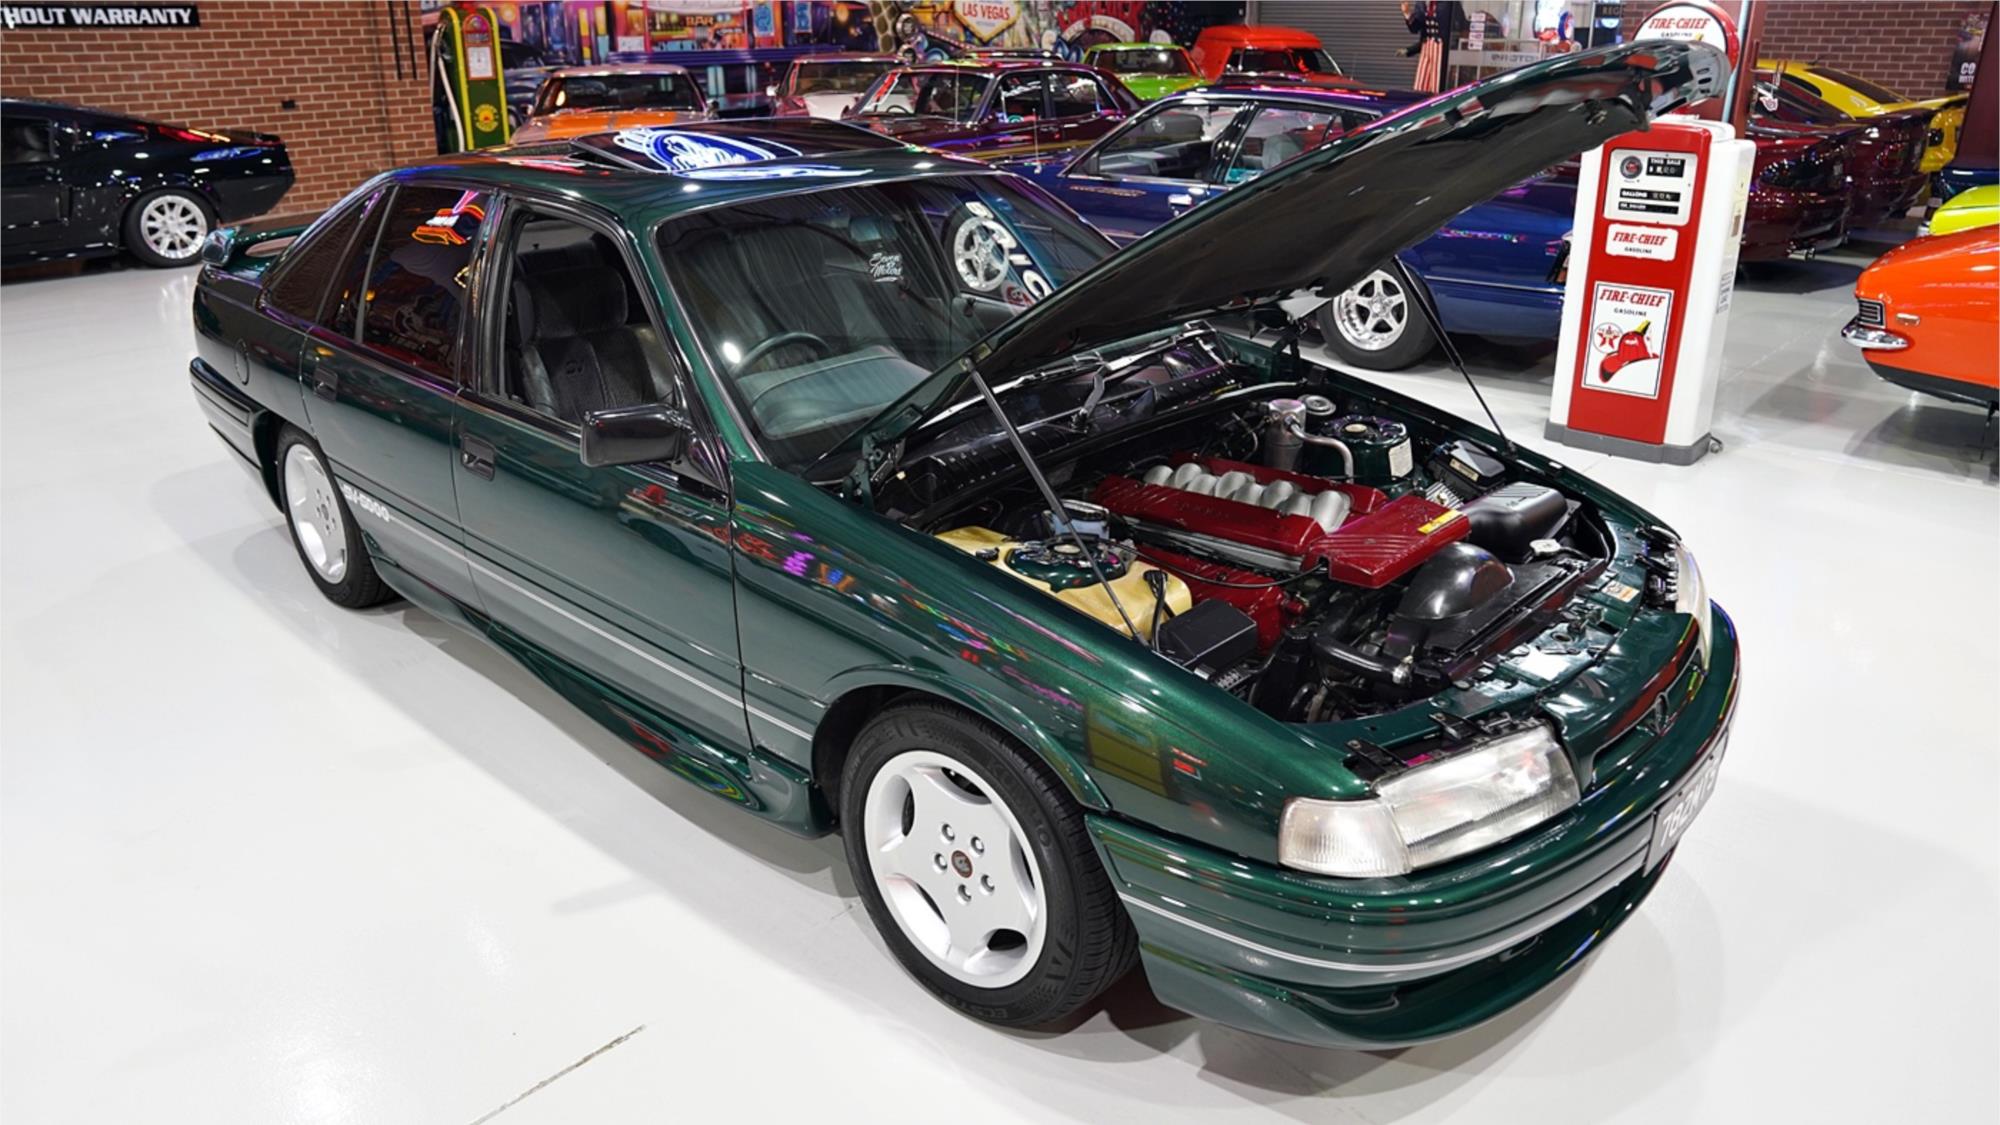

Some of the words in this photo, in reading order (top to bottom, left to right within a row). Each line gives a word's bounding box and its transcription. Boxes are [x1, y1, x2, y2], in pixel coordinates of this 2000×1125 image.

[0, 7, 66, 24] HOUT
[71, 8, 191, 25] WARRANTY
[962, 3, 977, 17] LAS
[980, 5, 1010, 20] VEGAS
[686, 15, 714, 26] BAR
[1648, 18, 1711, 29] FIRE-CHIEF
[1613, 231, 1668, 246] FIRE-CHIEF
[1600, 289, 1666, 307] FIRE-CHIEF
[1613, 307, 1647, 316] GASOLINE
